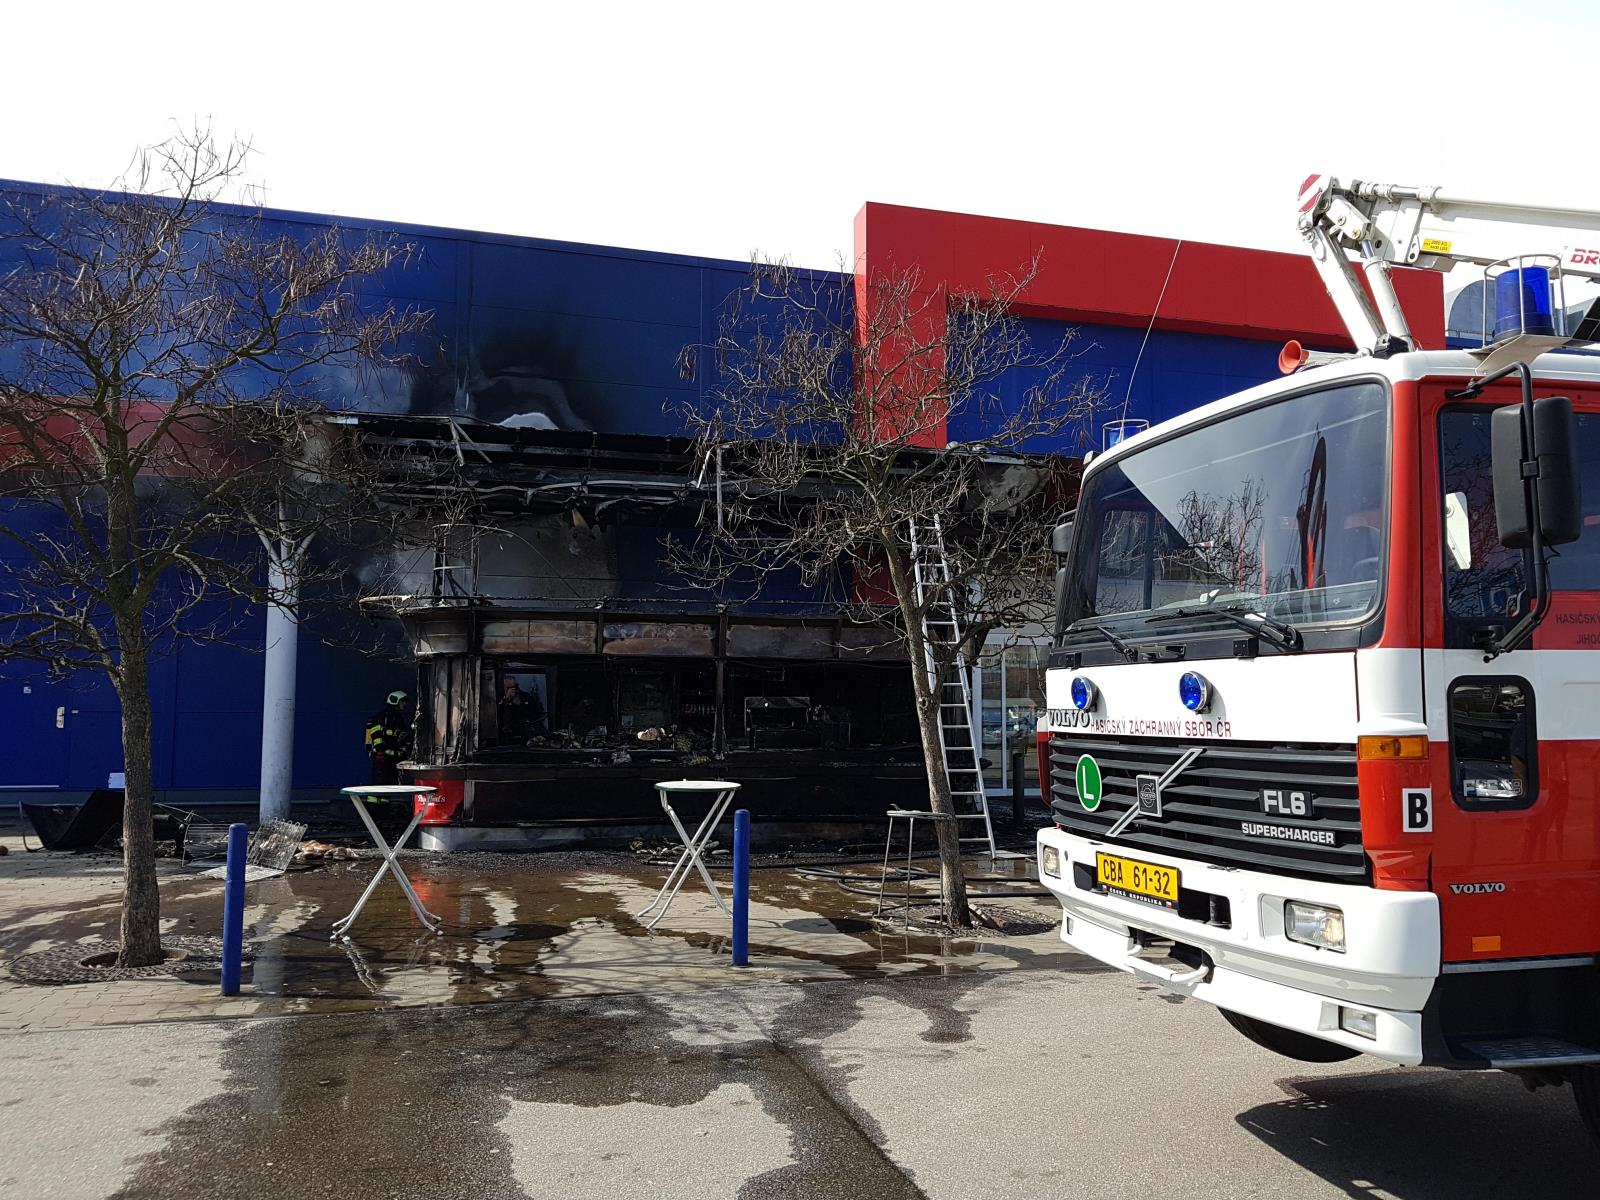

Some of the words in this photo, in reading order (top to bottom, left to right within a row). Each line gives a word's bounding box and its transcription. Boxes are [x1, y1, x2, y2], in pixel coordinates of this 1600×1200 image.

[1048, 709, 1092, 729] VOLVO
[1185, 721, 1213, 738] SBOR
[1216, 716, 1232, 738] ČR
[1082, 765, 1095, 800] L
[1263, 790, 1306, 815] FL6
[1408, 793, 1429, 829] B
[1241, 822, 1335, 845] SUPERCHARGER
[1103, 859, 1123, 884] CBA
[1134, 865, 1171, 895] 61-32
[1449, 881, 1506, 895] VOLVO
